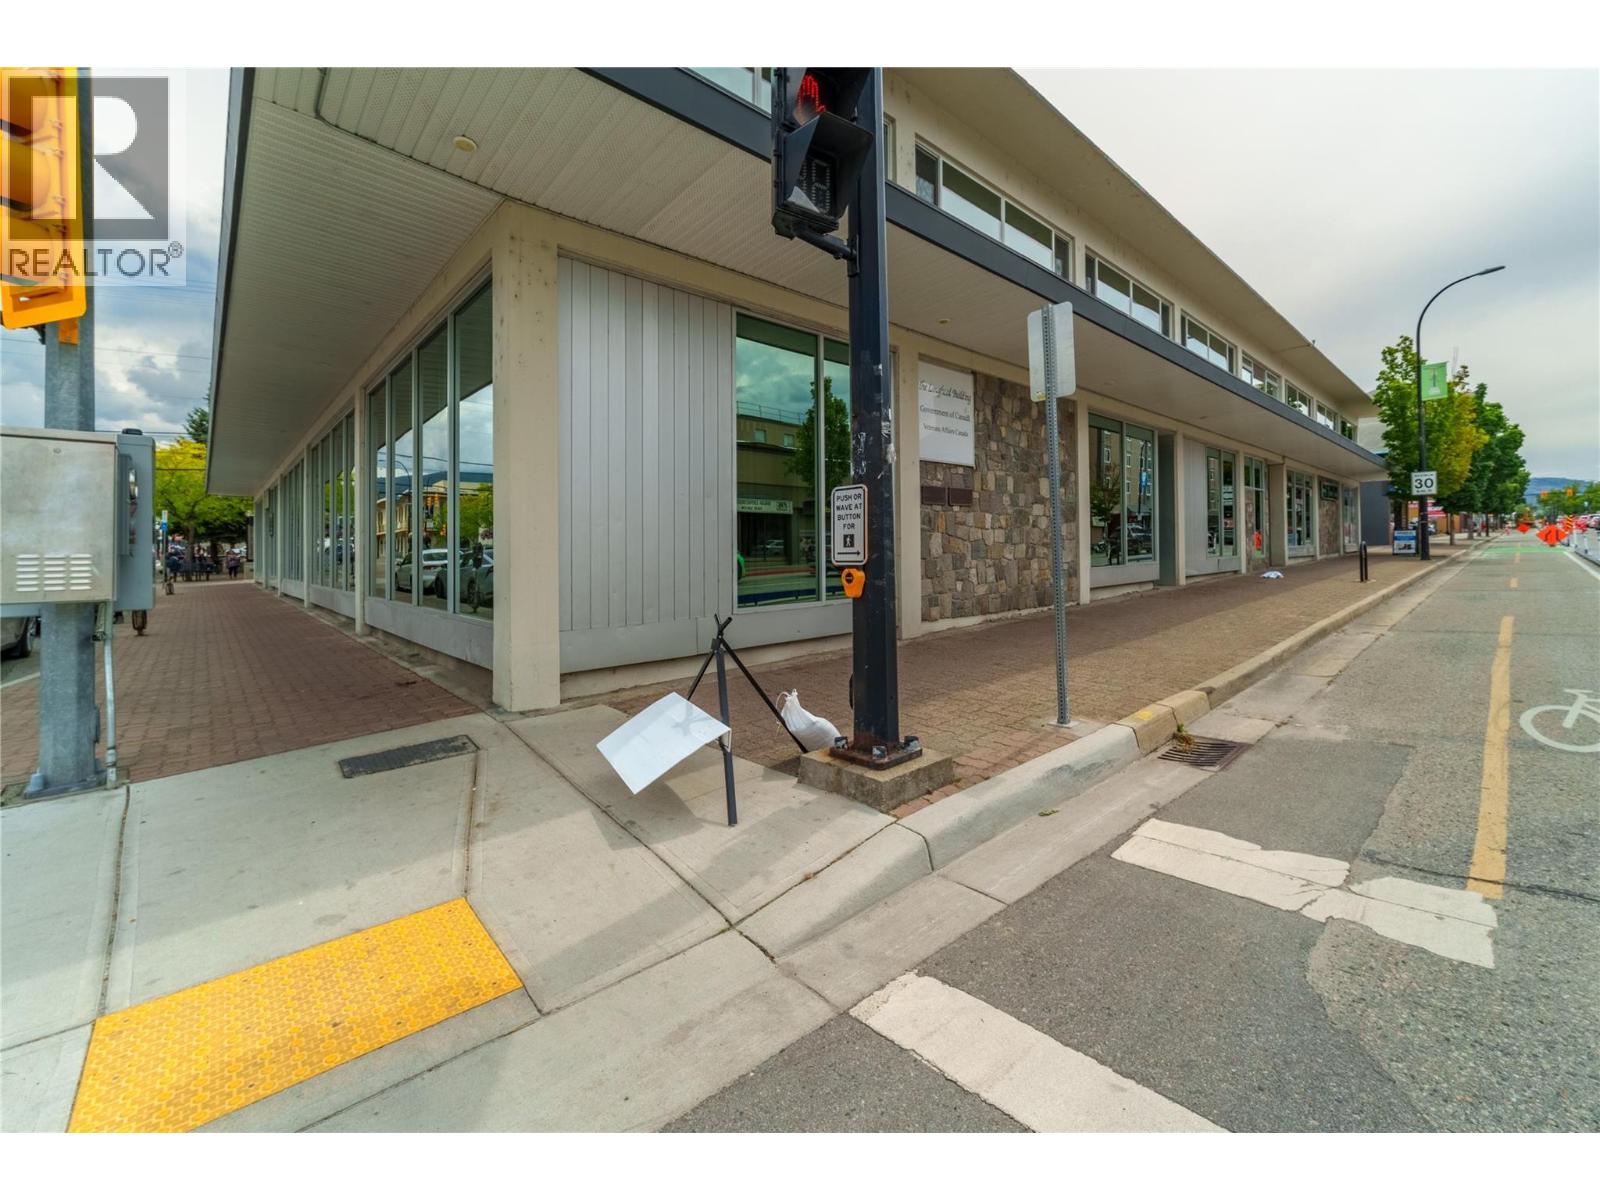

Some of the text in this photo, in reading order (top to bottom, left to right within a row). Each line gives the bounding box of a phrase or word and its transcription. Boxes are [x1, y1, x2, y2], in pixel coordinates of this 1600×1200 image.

[920, 405, 949, 418] Government
[955, 411, 970, 422] Canada
[1414, 478, 1434, 489] 30
[854, 502, 862, 510] AT
[837, 512, 861, 520] BUTTON
